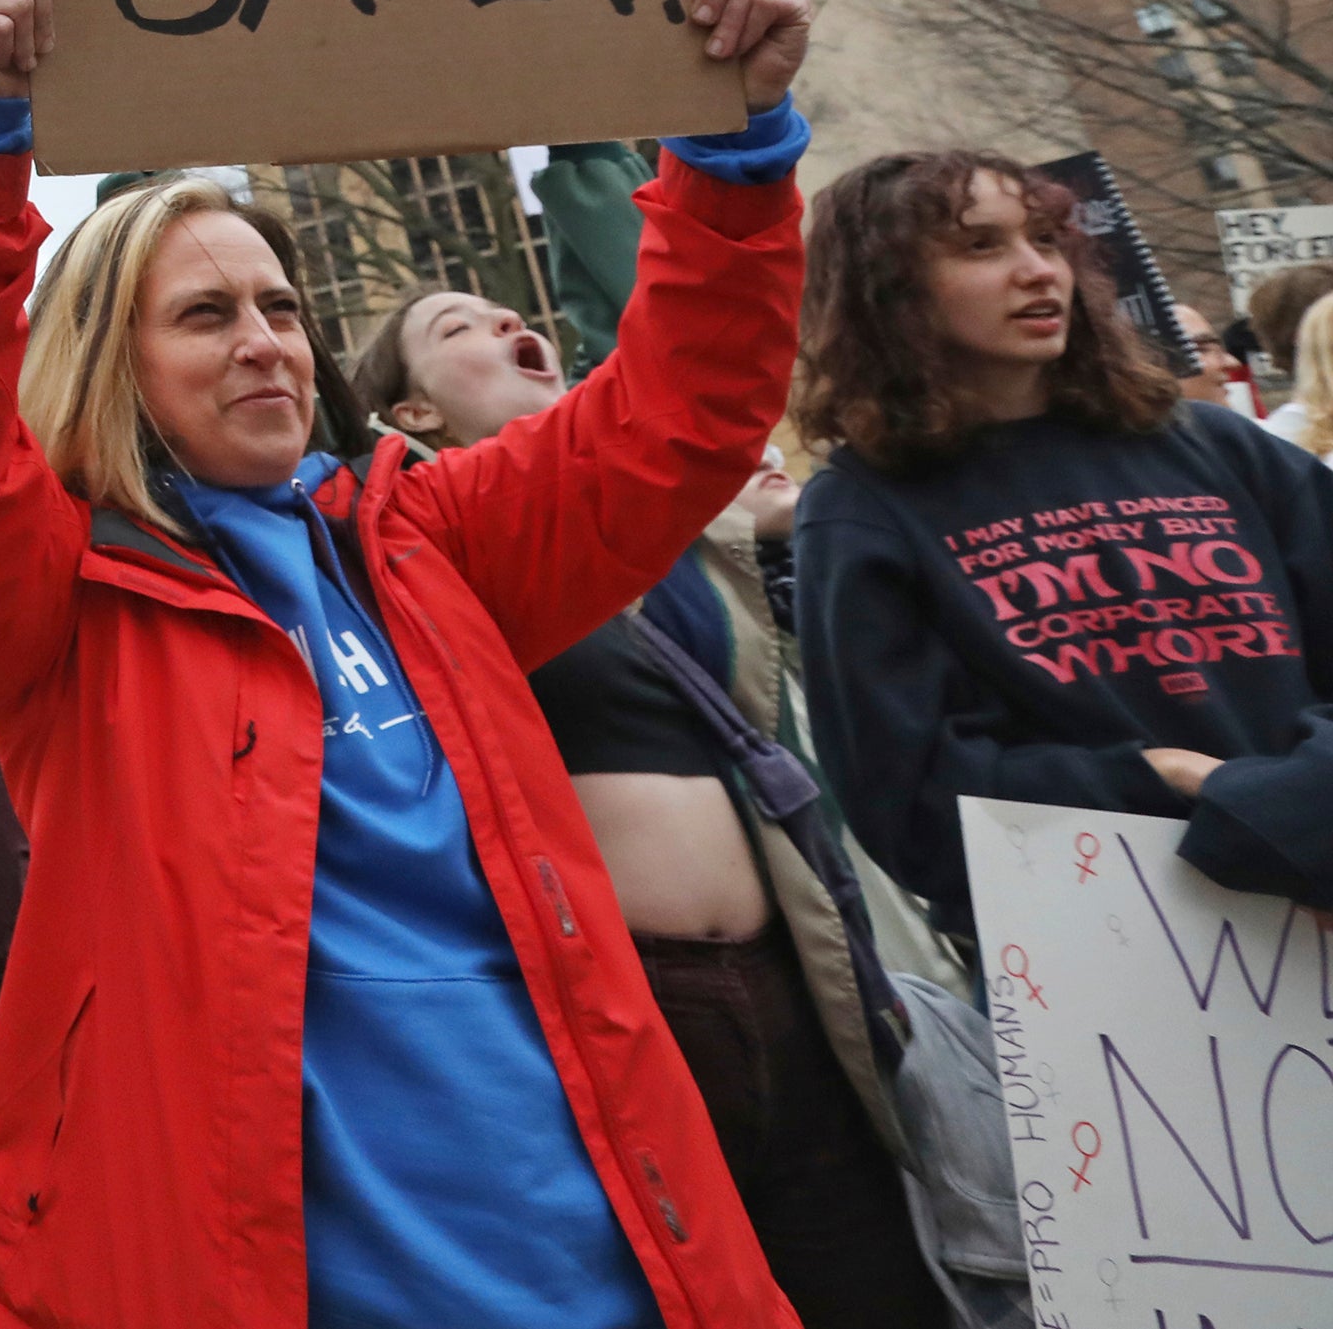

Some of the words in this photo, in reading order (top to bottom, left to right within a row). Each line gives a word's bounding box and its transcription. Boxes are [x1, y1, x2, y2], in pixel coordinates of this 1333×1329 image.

[1227, 236, 1333, 264] FORCE
[944, 535, 959, 551] I
[964, 518, 1024, 547] MAY
[1033, 501, 1112, 528] HAVE
[1115, 495, 1231, 516] DANCED
[957, 541, 1029, 574] FOR
[1033, 521, 1146, 554] MONEY
[1158, 518, 1239, 536] BUT
[973, 553, 1123, 622] I'M
[1120, 539, 1264, 591] NO
[1005, 591, 1285, 649] CORPORATE
[1022, 621, 1302, 685] WHORE
[988, 974, 1047, 1143] HUMANS
